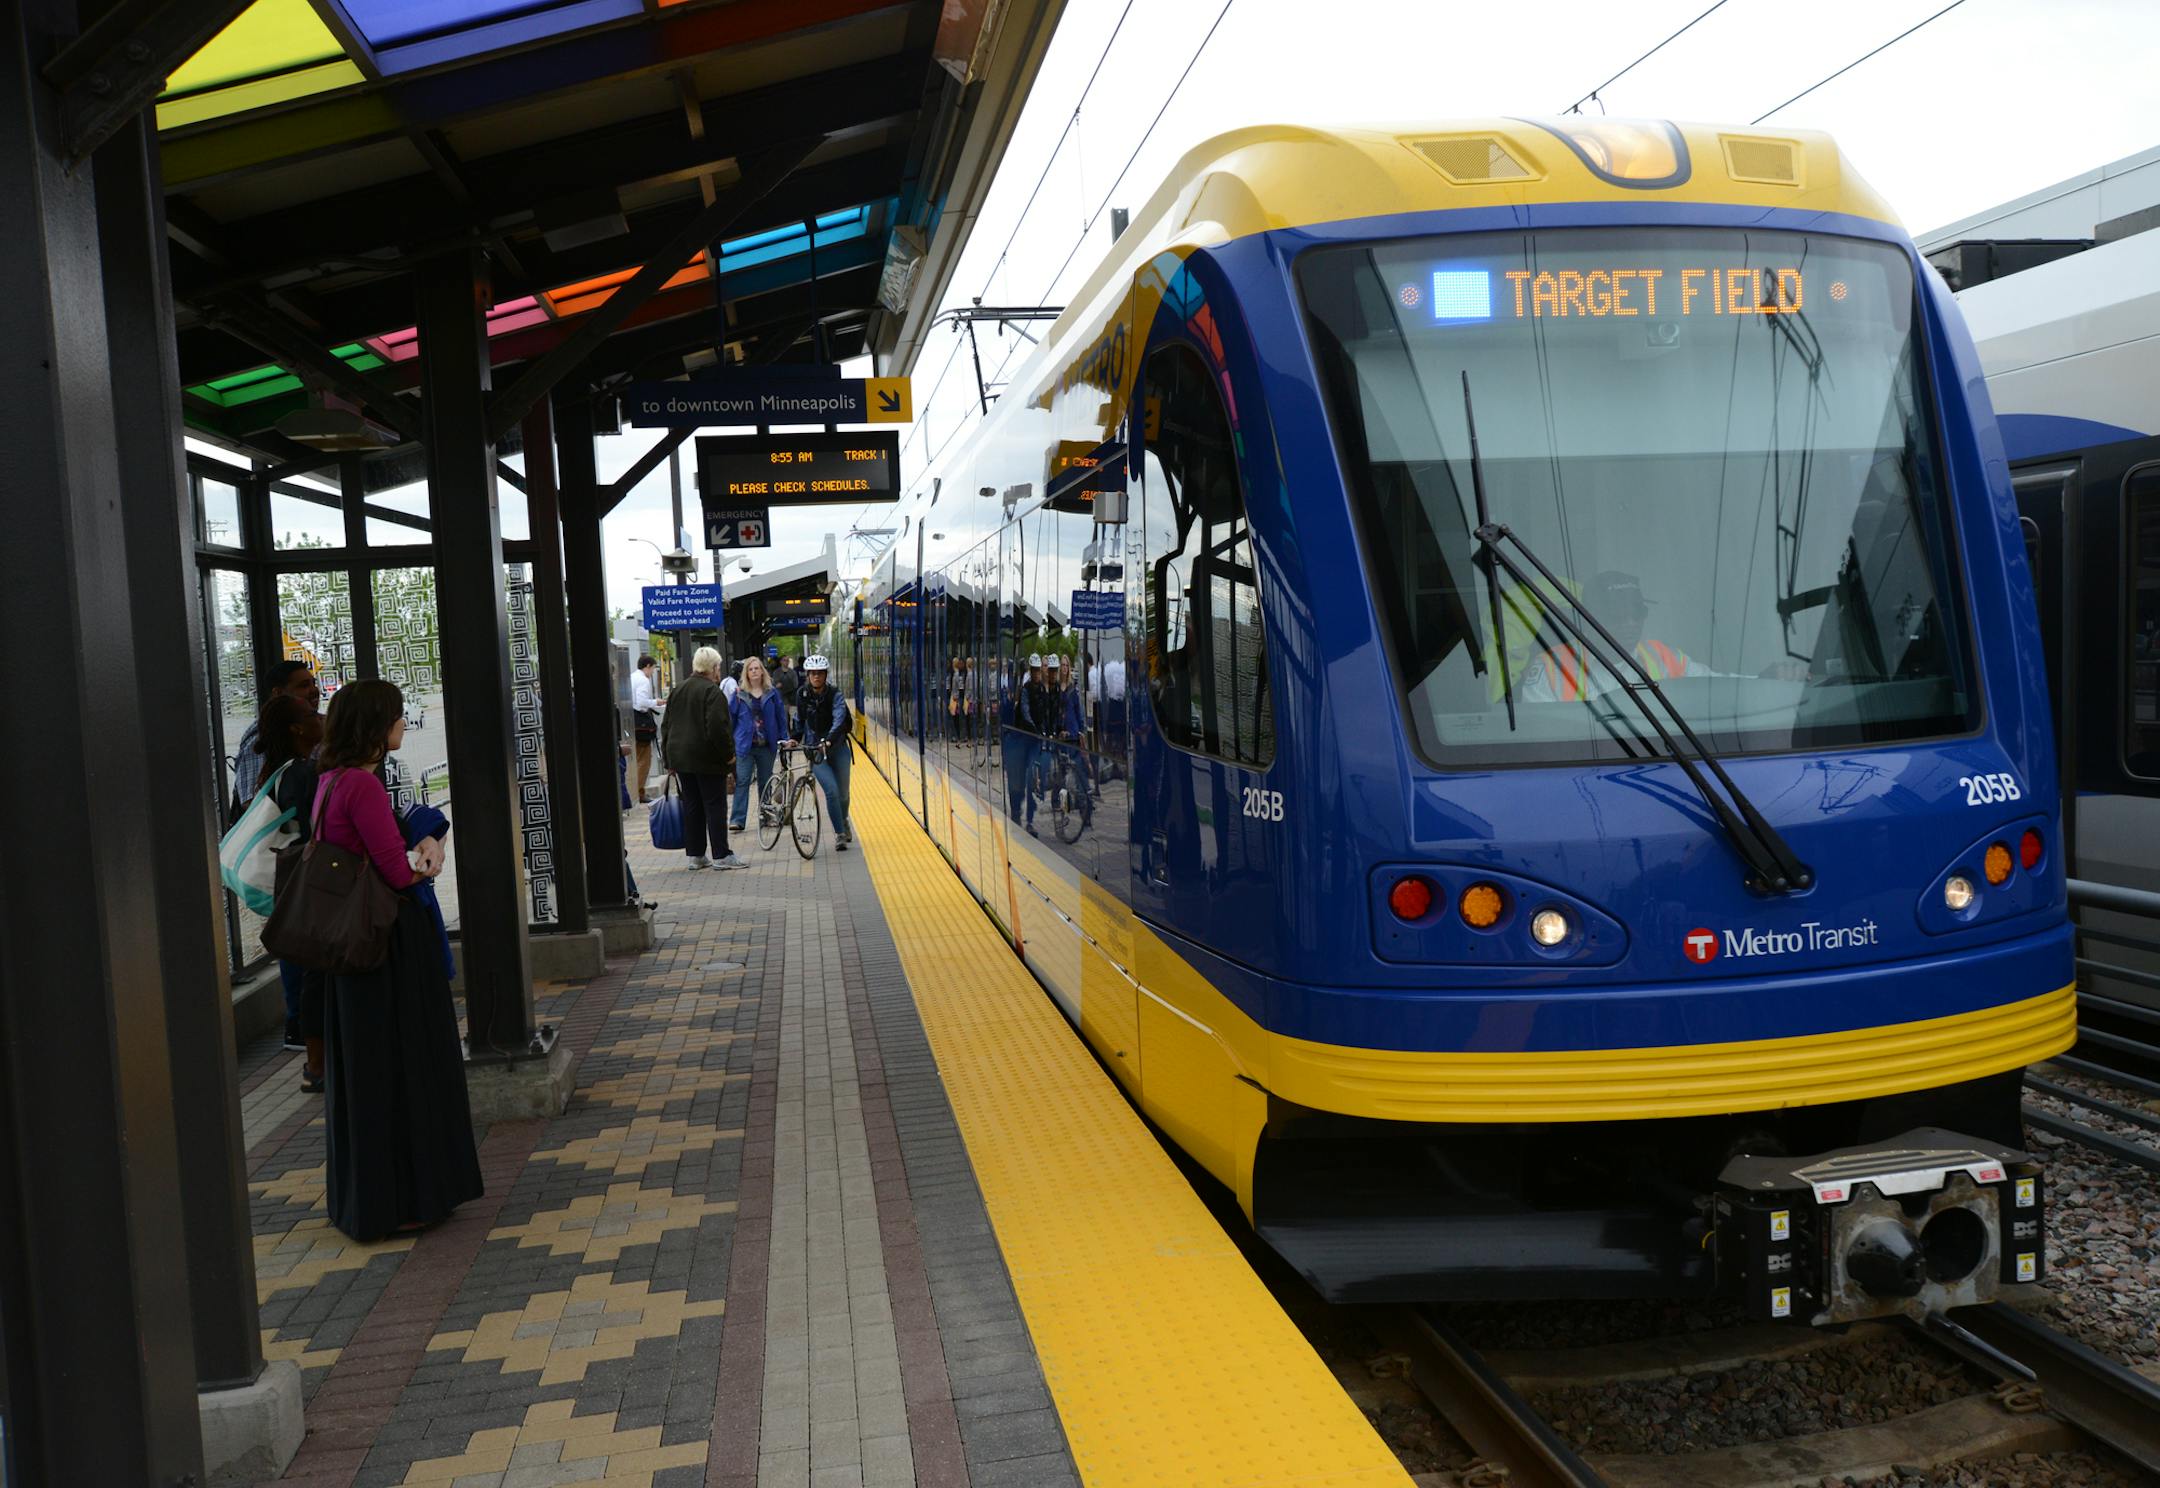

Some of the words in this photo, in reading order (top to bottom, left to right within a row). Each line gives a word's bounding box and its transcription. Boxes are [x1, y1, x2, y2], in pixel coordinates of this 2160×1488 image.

[1505, 269, 1663, 318] TARGET
[1682, 267, 1804, 315] FIELD
[642, 400, 660, 414] to
[666, 396, 755, 414] downtown
[761, 395, 857, 414] Minneapolis
[770, 451, 793, 463] 8:55
[799, 451, 813, 463] AM
[844, 449, 877, 461] TRACK
[729, 481, 768, 494] PLEASE
[774, 480, 806, 493] CHECK
[811, 479, 871, 492] SCHEDULES.
[706, 510, 766, 520] EMERGENCY
[655, 588, 671, 596] Paid
[672, 588, 688, 596] Fare
[690, 587, 709, 595] Zone
[647, 598, 666, 606] Valid
[667, 597, 683, 605] Fare
[685, 596, 717, 606] Required
[651, 609, 682, 617] Proceed
[694, 608, 715, 616] ticket
[657, 617, 688, 625] machine
[689, 616, 711, 624] ahead
[1958, 772, 2022, 807] 205B
[1243, 787, 1284, 822] 205B
[1687, 935, 1715, 960] T
